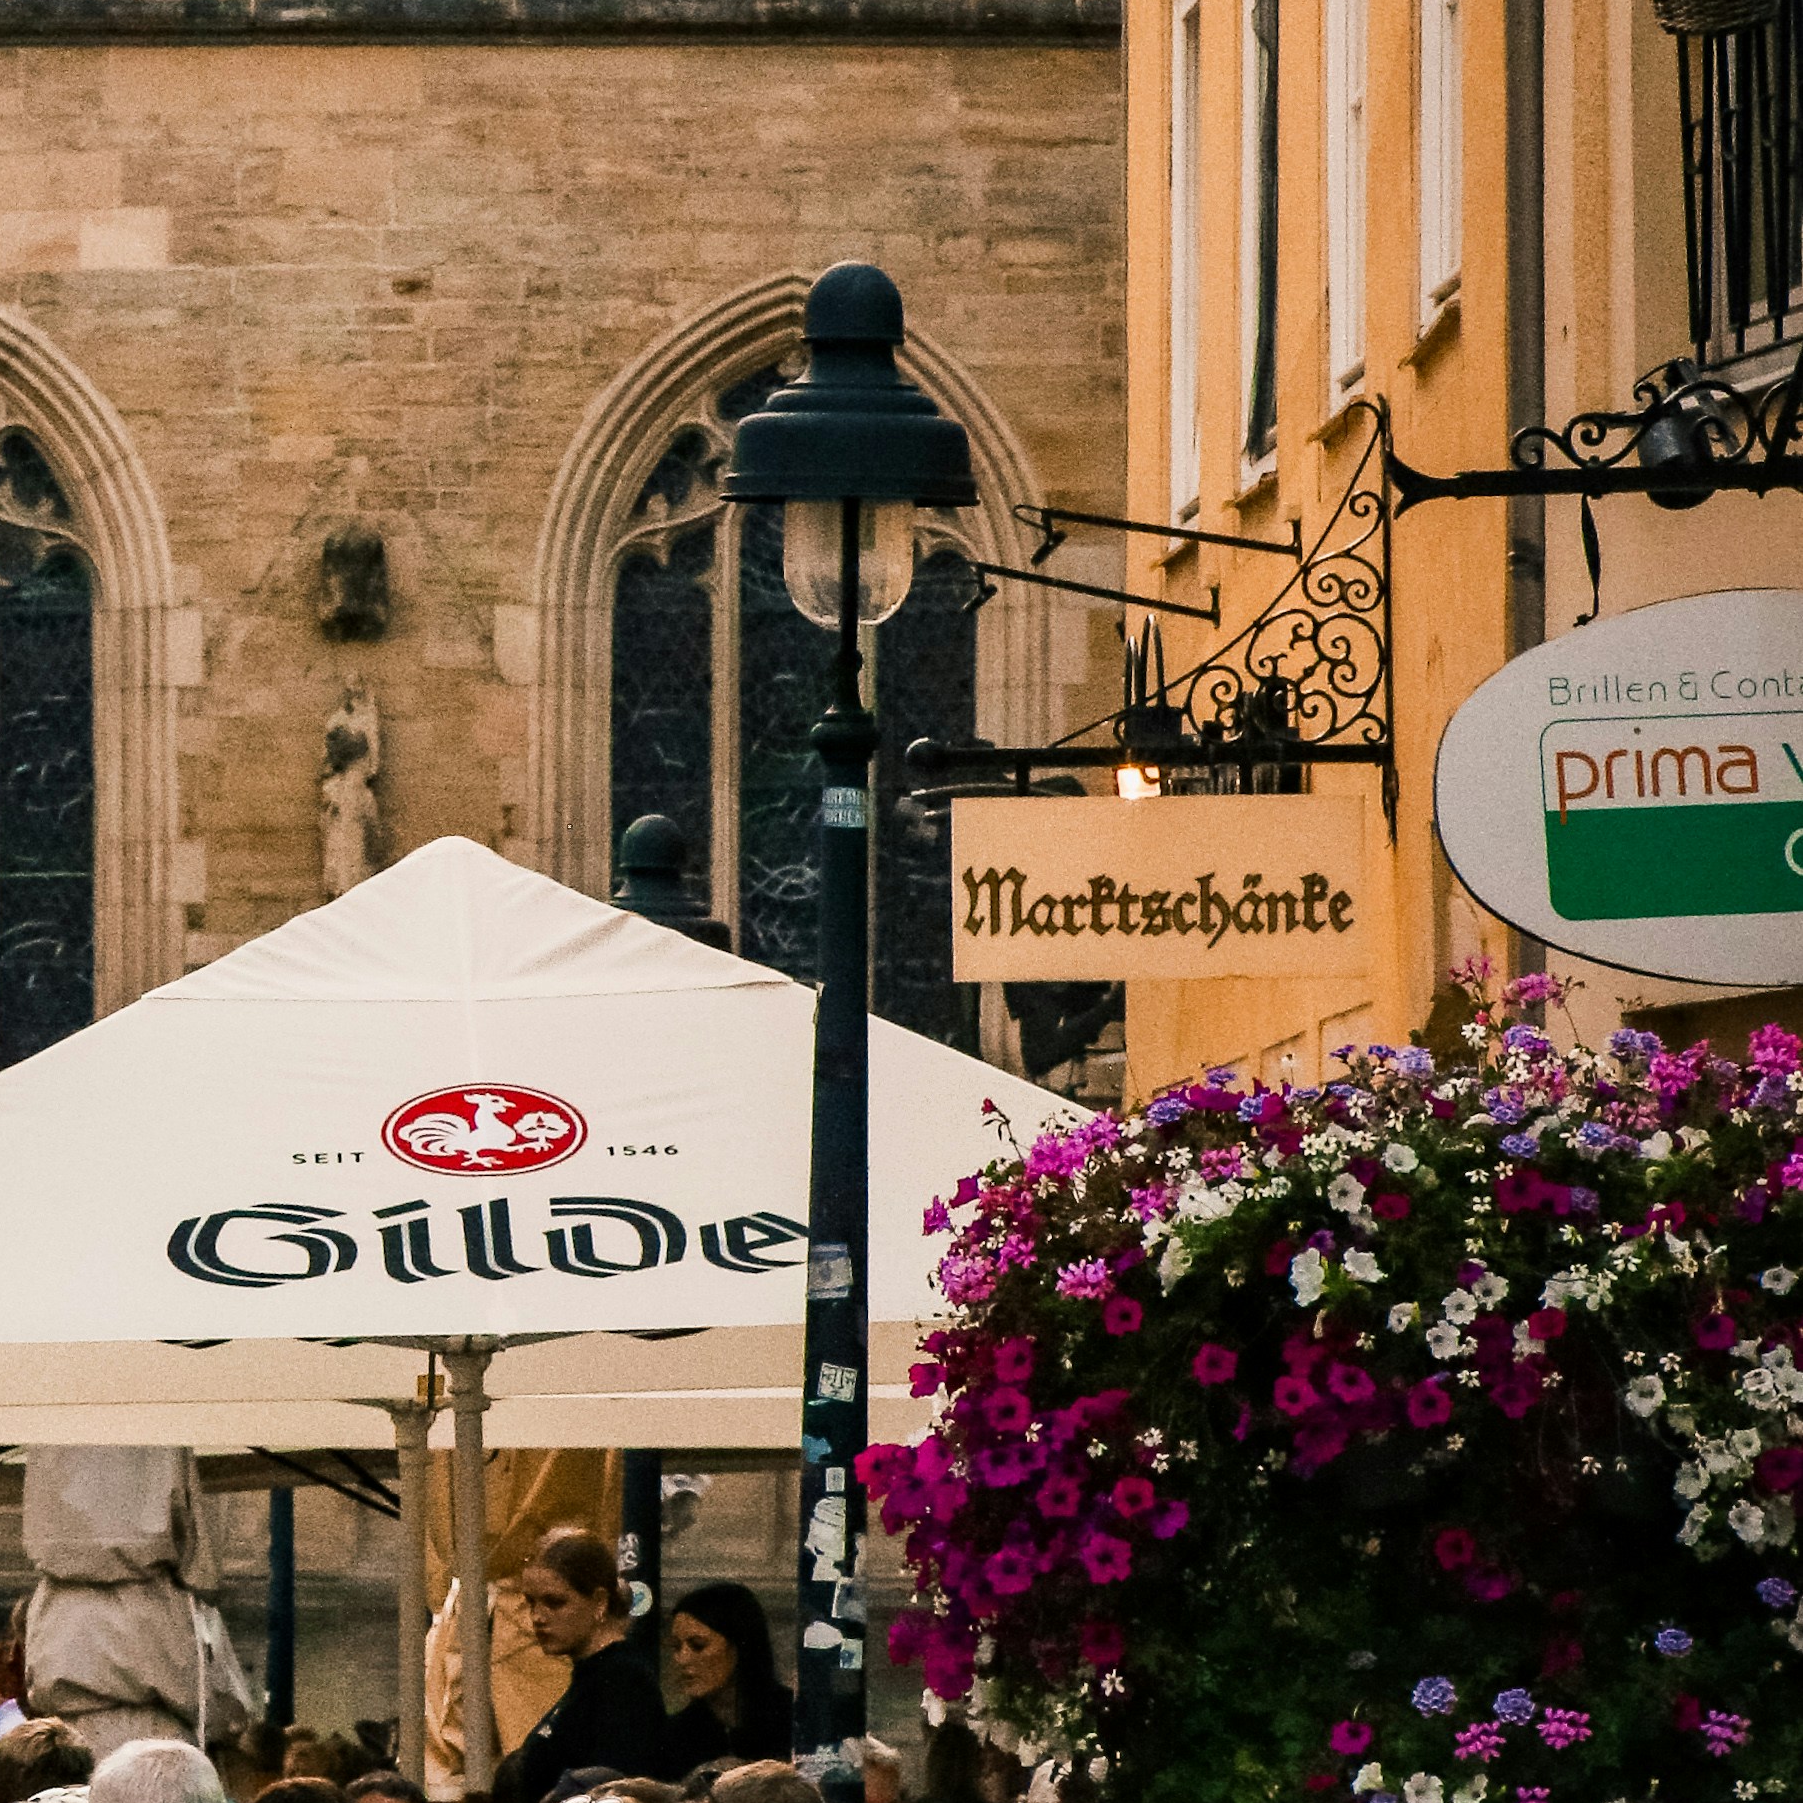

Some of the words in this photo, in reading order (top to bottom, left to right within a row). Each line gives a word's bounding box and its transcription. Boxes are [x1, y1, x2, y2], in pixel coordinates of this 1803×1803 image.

[1548, 674, 1667, 706] Brillen
[1678, 671, 1699, 702] &
[1555, 743, 1760, 826] prima
[961, 866, 1355, 950] Marktschänke
[291, 1151, 366, 1166] SEIT
[605, 1143, 680, 1158] 1546
